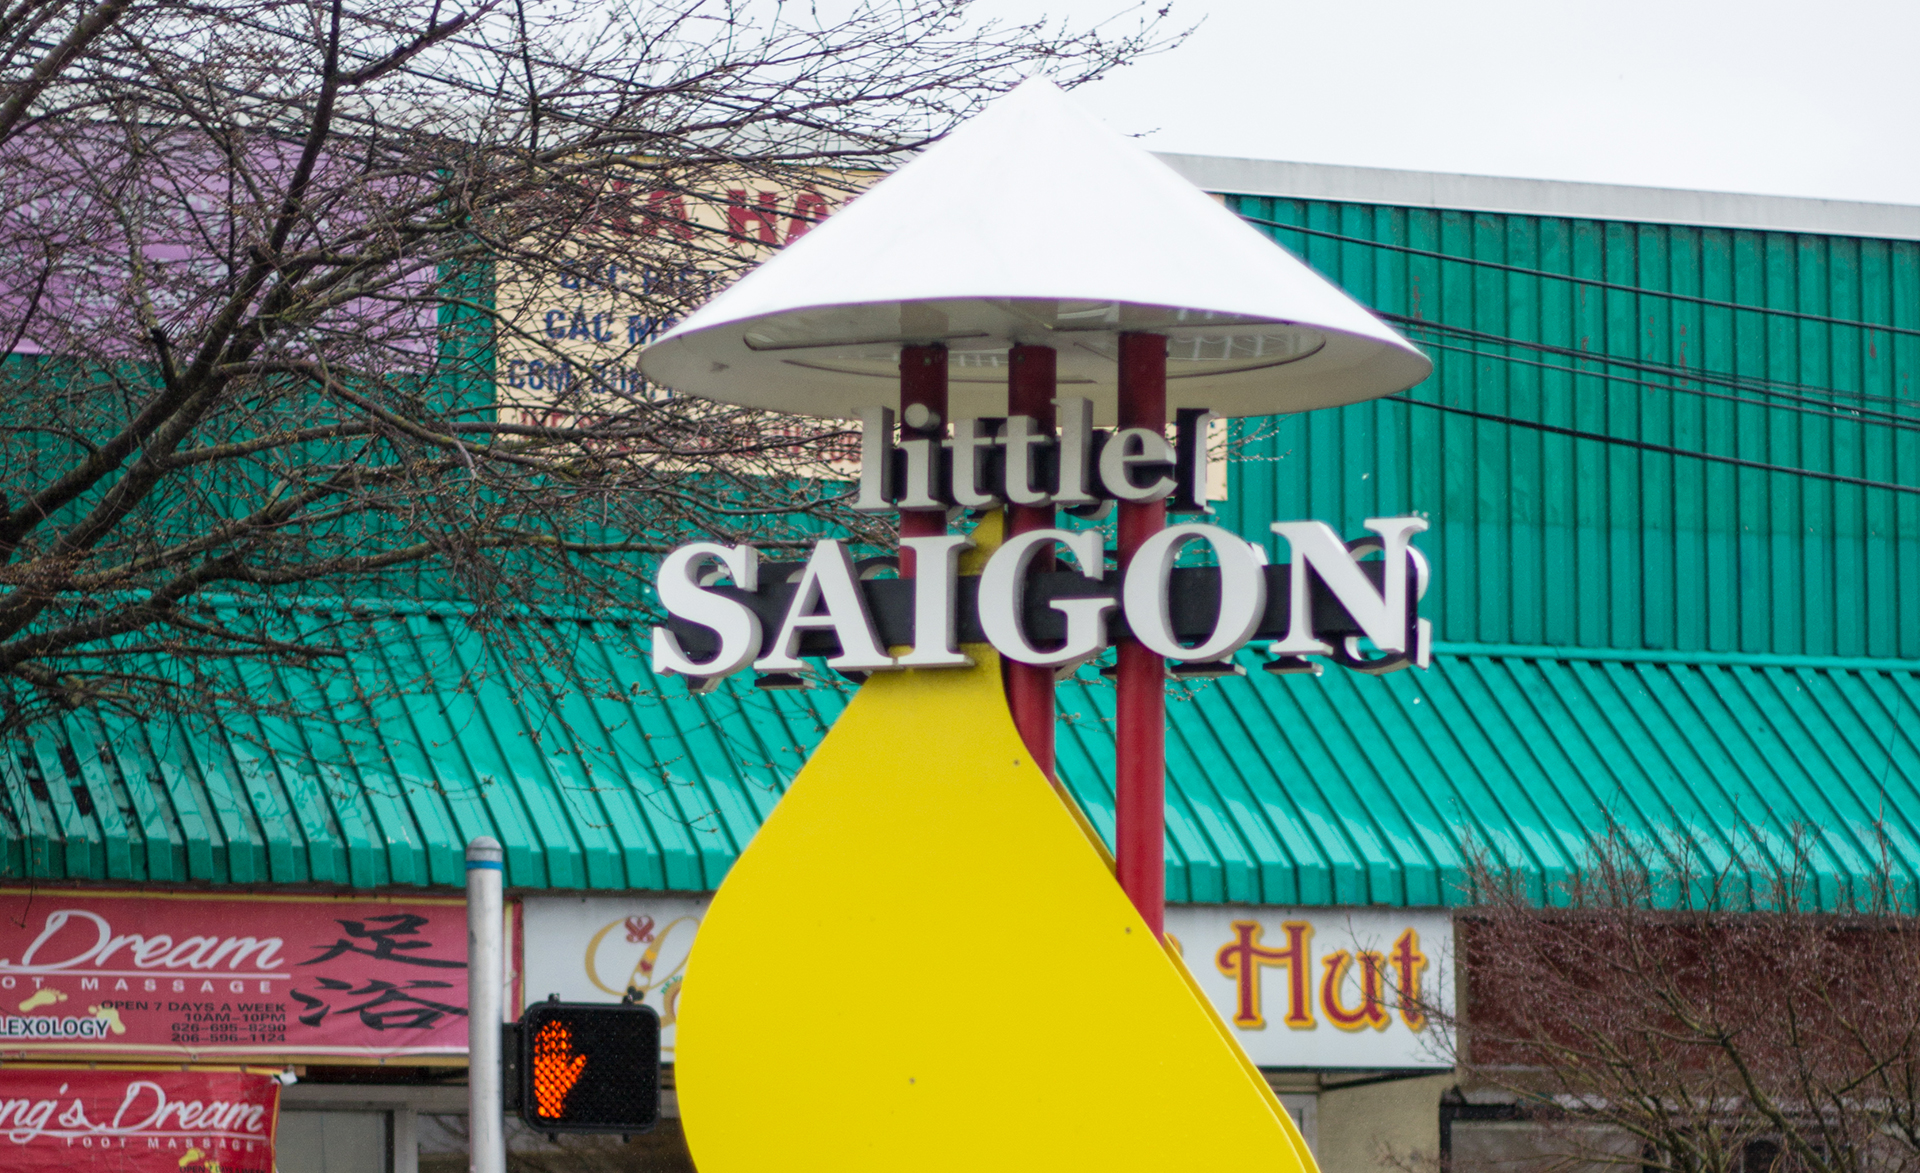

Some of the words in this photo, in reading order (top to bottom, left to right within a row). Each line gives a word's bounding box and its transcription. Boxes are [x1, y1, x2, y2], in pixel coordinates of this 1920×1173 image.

[852, 396, 1179, 513] little
[653, 517, 1429, 677] SAIGON
[21, 909, 285, 970] Dream
[80, 977, 272, 993] MASSAGE
[1215, 920, 1429, 1032] Hut
[101, 1000, 149, 1011] OPEN
[154, 1001, 163, 1011] 7
[168, 1001, 215, 1012] DAYS
[220, 1002, 232, 1012] A
[237, 1003, 286, 1013] WEEK
[112, 1081, 264, 1132] Dream
[67, 1136, 126, 1148] FOOT
[148, 1136, 254, 1153] MASSAGE
